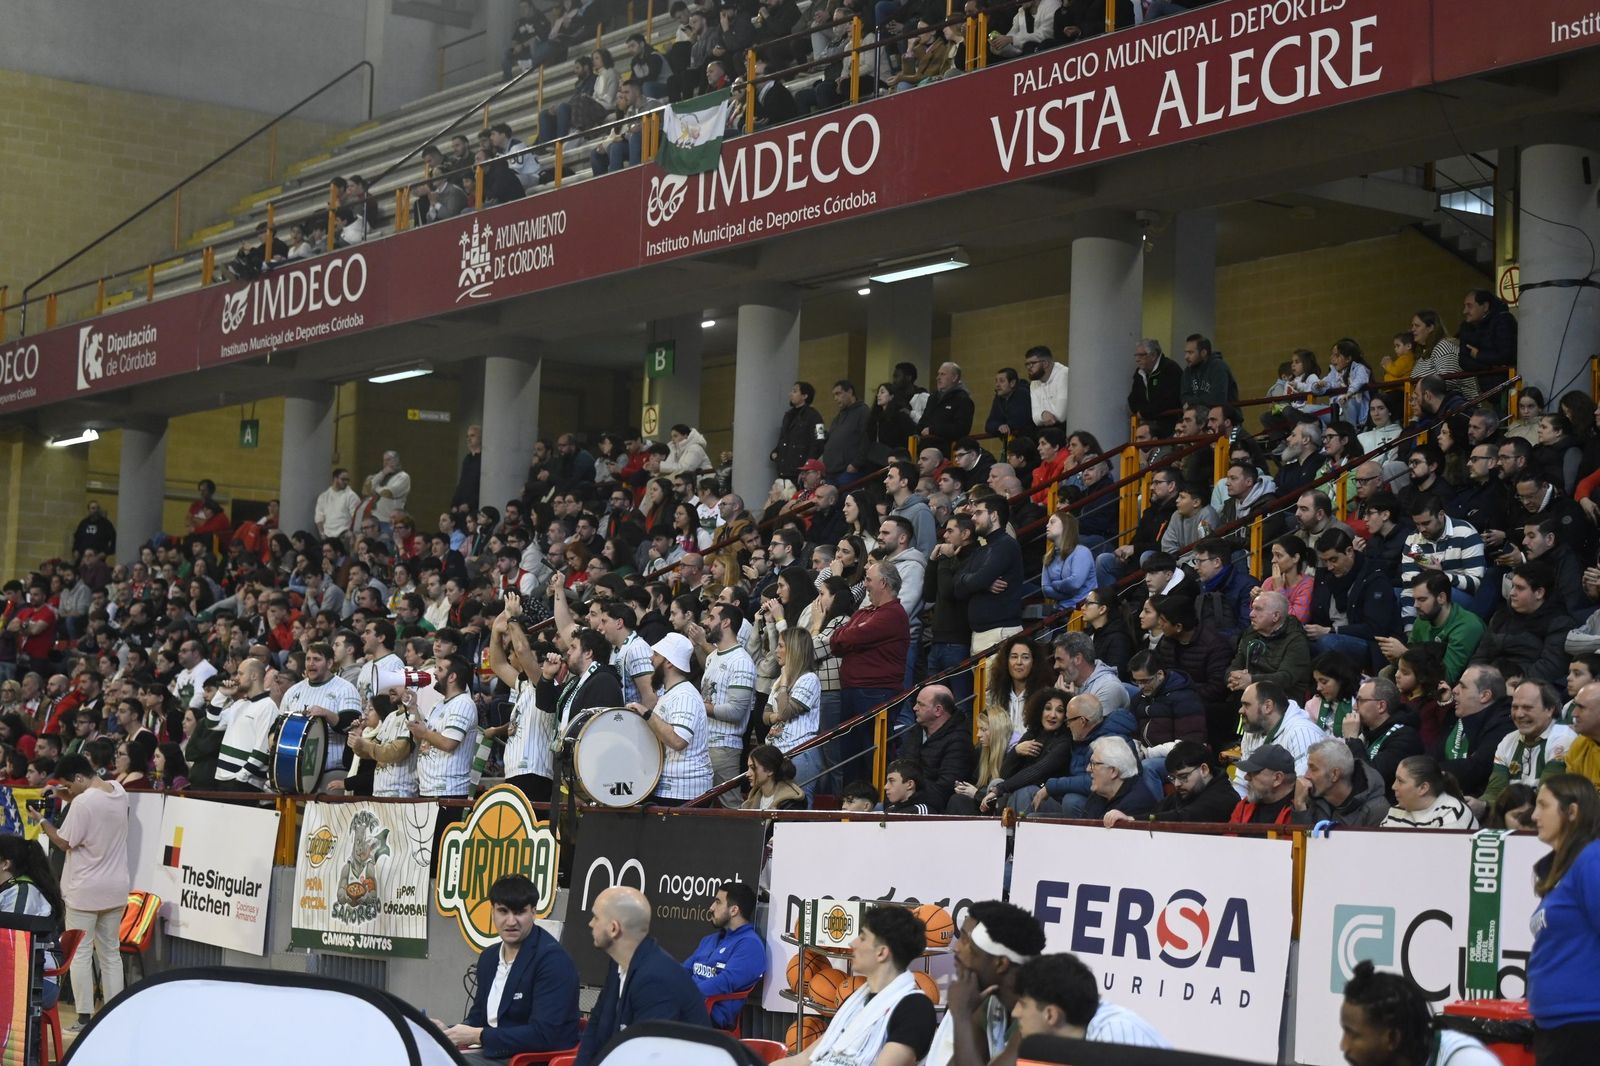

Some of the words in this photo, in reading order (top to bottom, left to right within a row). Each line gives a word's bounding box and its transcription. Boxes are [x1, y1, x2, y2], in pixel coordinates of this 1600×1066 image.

[1013, 52, 1099, 96] PALACIO
[1104, 18, 1223, 72] MUNICIPAL
[990, 85, 1131, 173] VISTA
[1148, 15, 1383, 136] ALEGRE
[696, 113, 881, 214] IMDECO
[494, 210, 567, 251] AYUNTAMIENTO
[646, 234, 690, 257] Instituto
[692, 218, 746, 246] Municipal
[748, 215, 763, 232] de
[766, 204, 821, 230] Deportes
[823, 189, 877, 215] Córdoba
[494, 255, 506, 280] DE
[508, 243, 555, 276] CÓRDOBA
[252, 253, 367, 326] IMDECO
[107, 324, 157, 355] Diputación
[220, 341, 249, 358] Instituto
[249, 331, 284, 352] Municipal
[284, 328, 295, 343] de
[295, 321, 330, 342] Deportes
[331, 312, 364, 332] Córdoba
[106, 360, 118, 377] de
[119, 349, 157, 374] Córdoba
[655, 348, 666, 371] B
[244, 424, 252, 444] A
[180, 888, 231, 917] Kitchen
[659, 872, 743, 902] nogom
[1033, 880, 1256, 973] FERSA
[1103, 972, 1251, 1009] URIDAD
